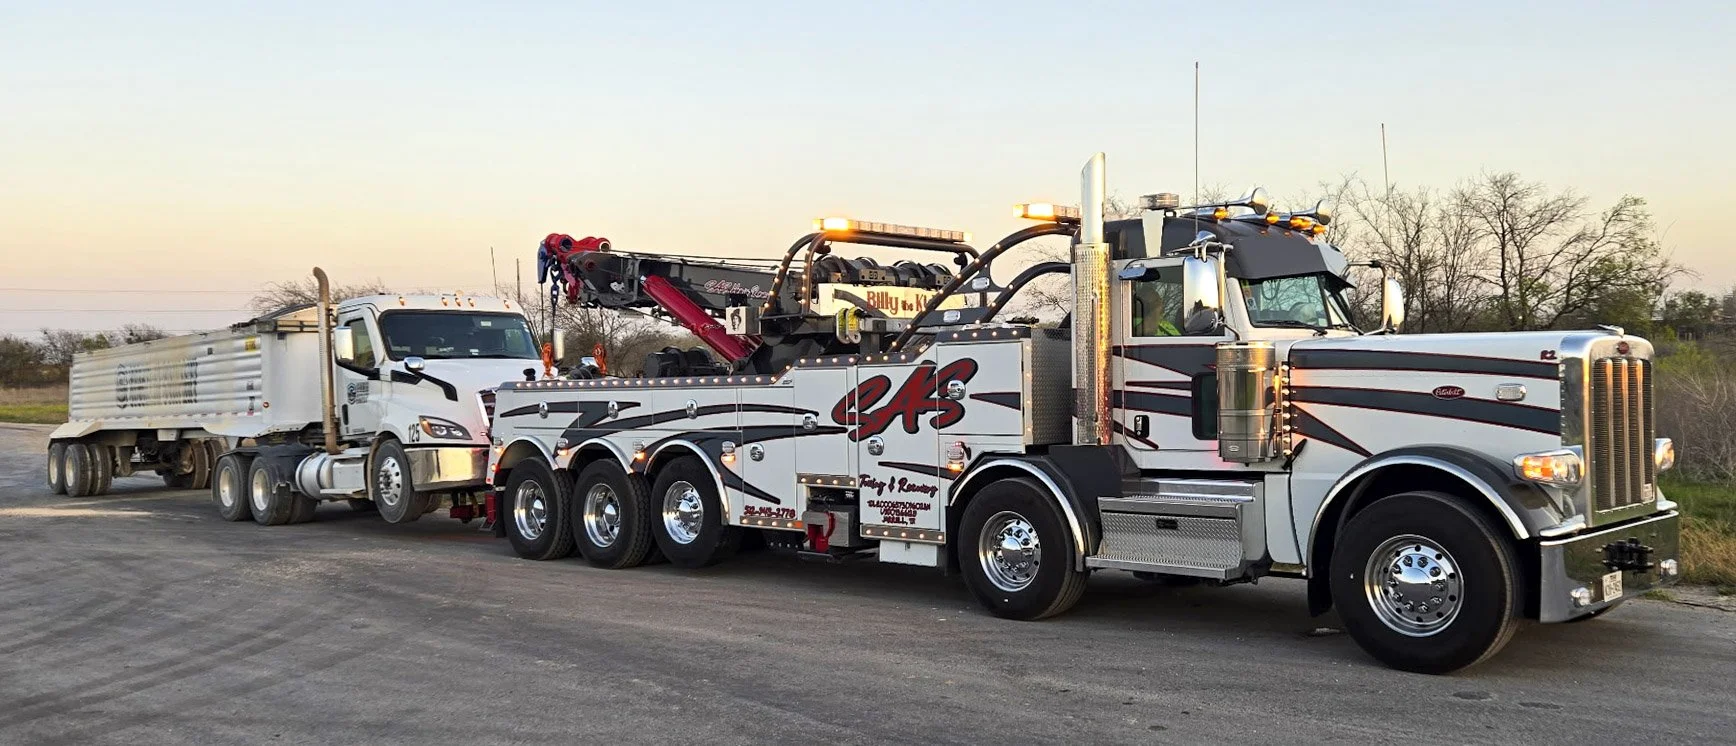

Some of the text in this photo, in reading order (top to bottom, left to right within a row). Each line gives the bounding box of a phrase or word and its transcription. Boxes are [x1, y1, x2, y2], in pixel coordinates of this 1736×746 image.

[867, 291, 898, 315] Billy
[831, 358, 978, 442] SAS
[409, 423, 420, 442] 125
[859, 474, 886, 496] Towing
[898, 477, 938, 498] Recovery
